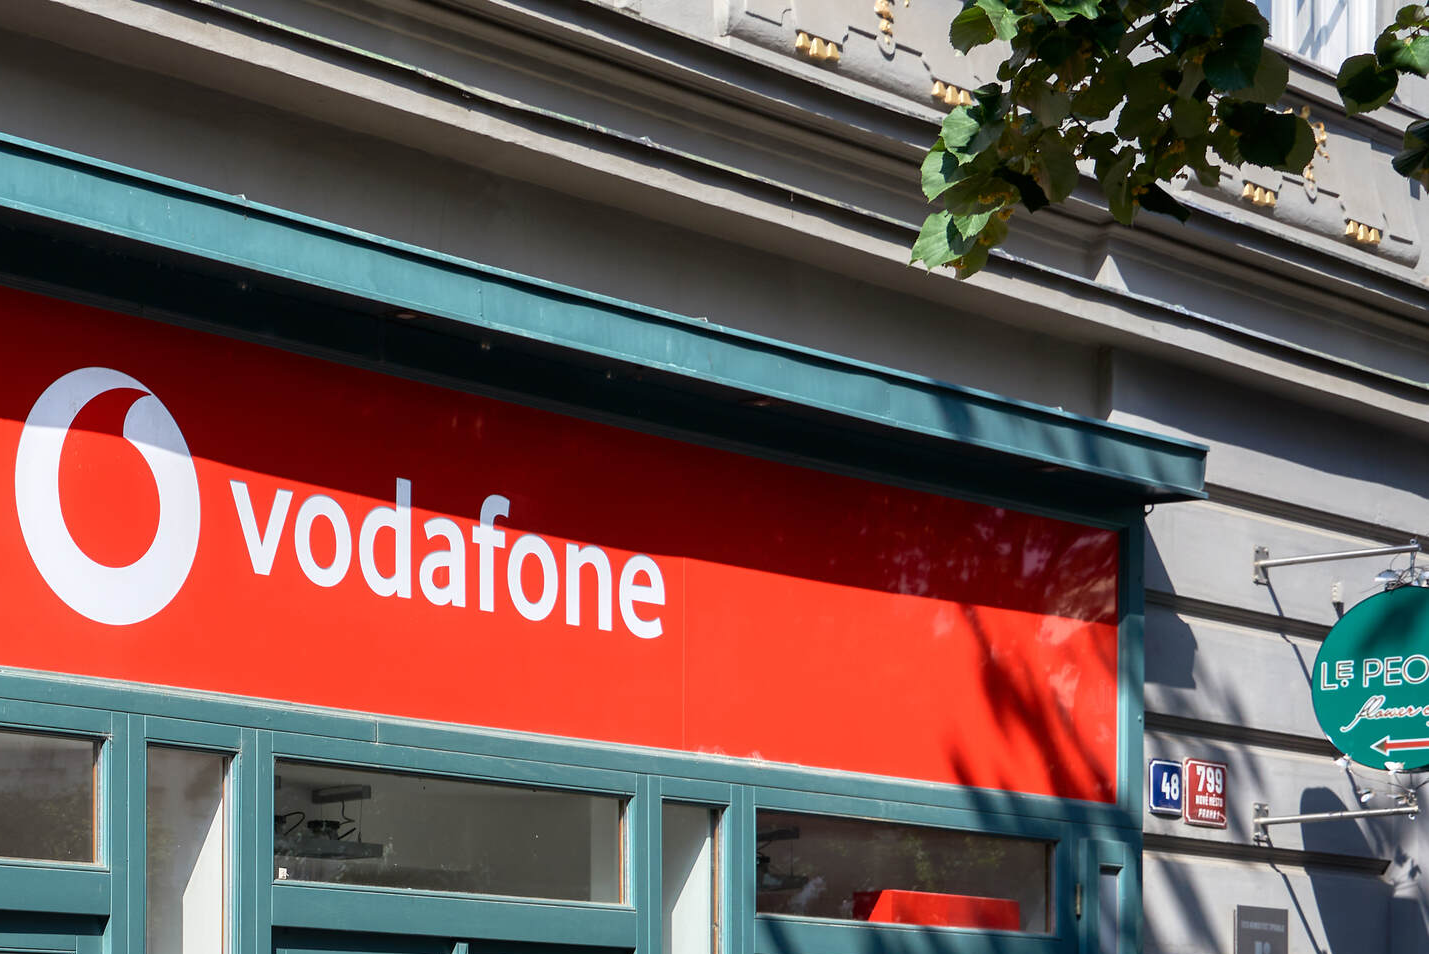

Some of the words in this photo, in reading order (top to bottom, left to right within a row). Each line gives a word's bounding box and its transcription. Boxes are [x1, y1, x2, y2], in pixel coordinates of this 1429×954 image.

[229, 477, 666, 640] vodafone
[1339, 695, 1423, 732] flower
[1161, 771, 1180, 800] 48
[1196, 765, 1223, 794] 799
